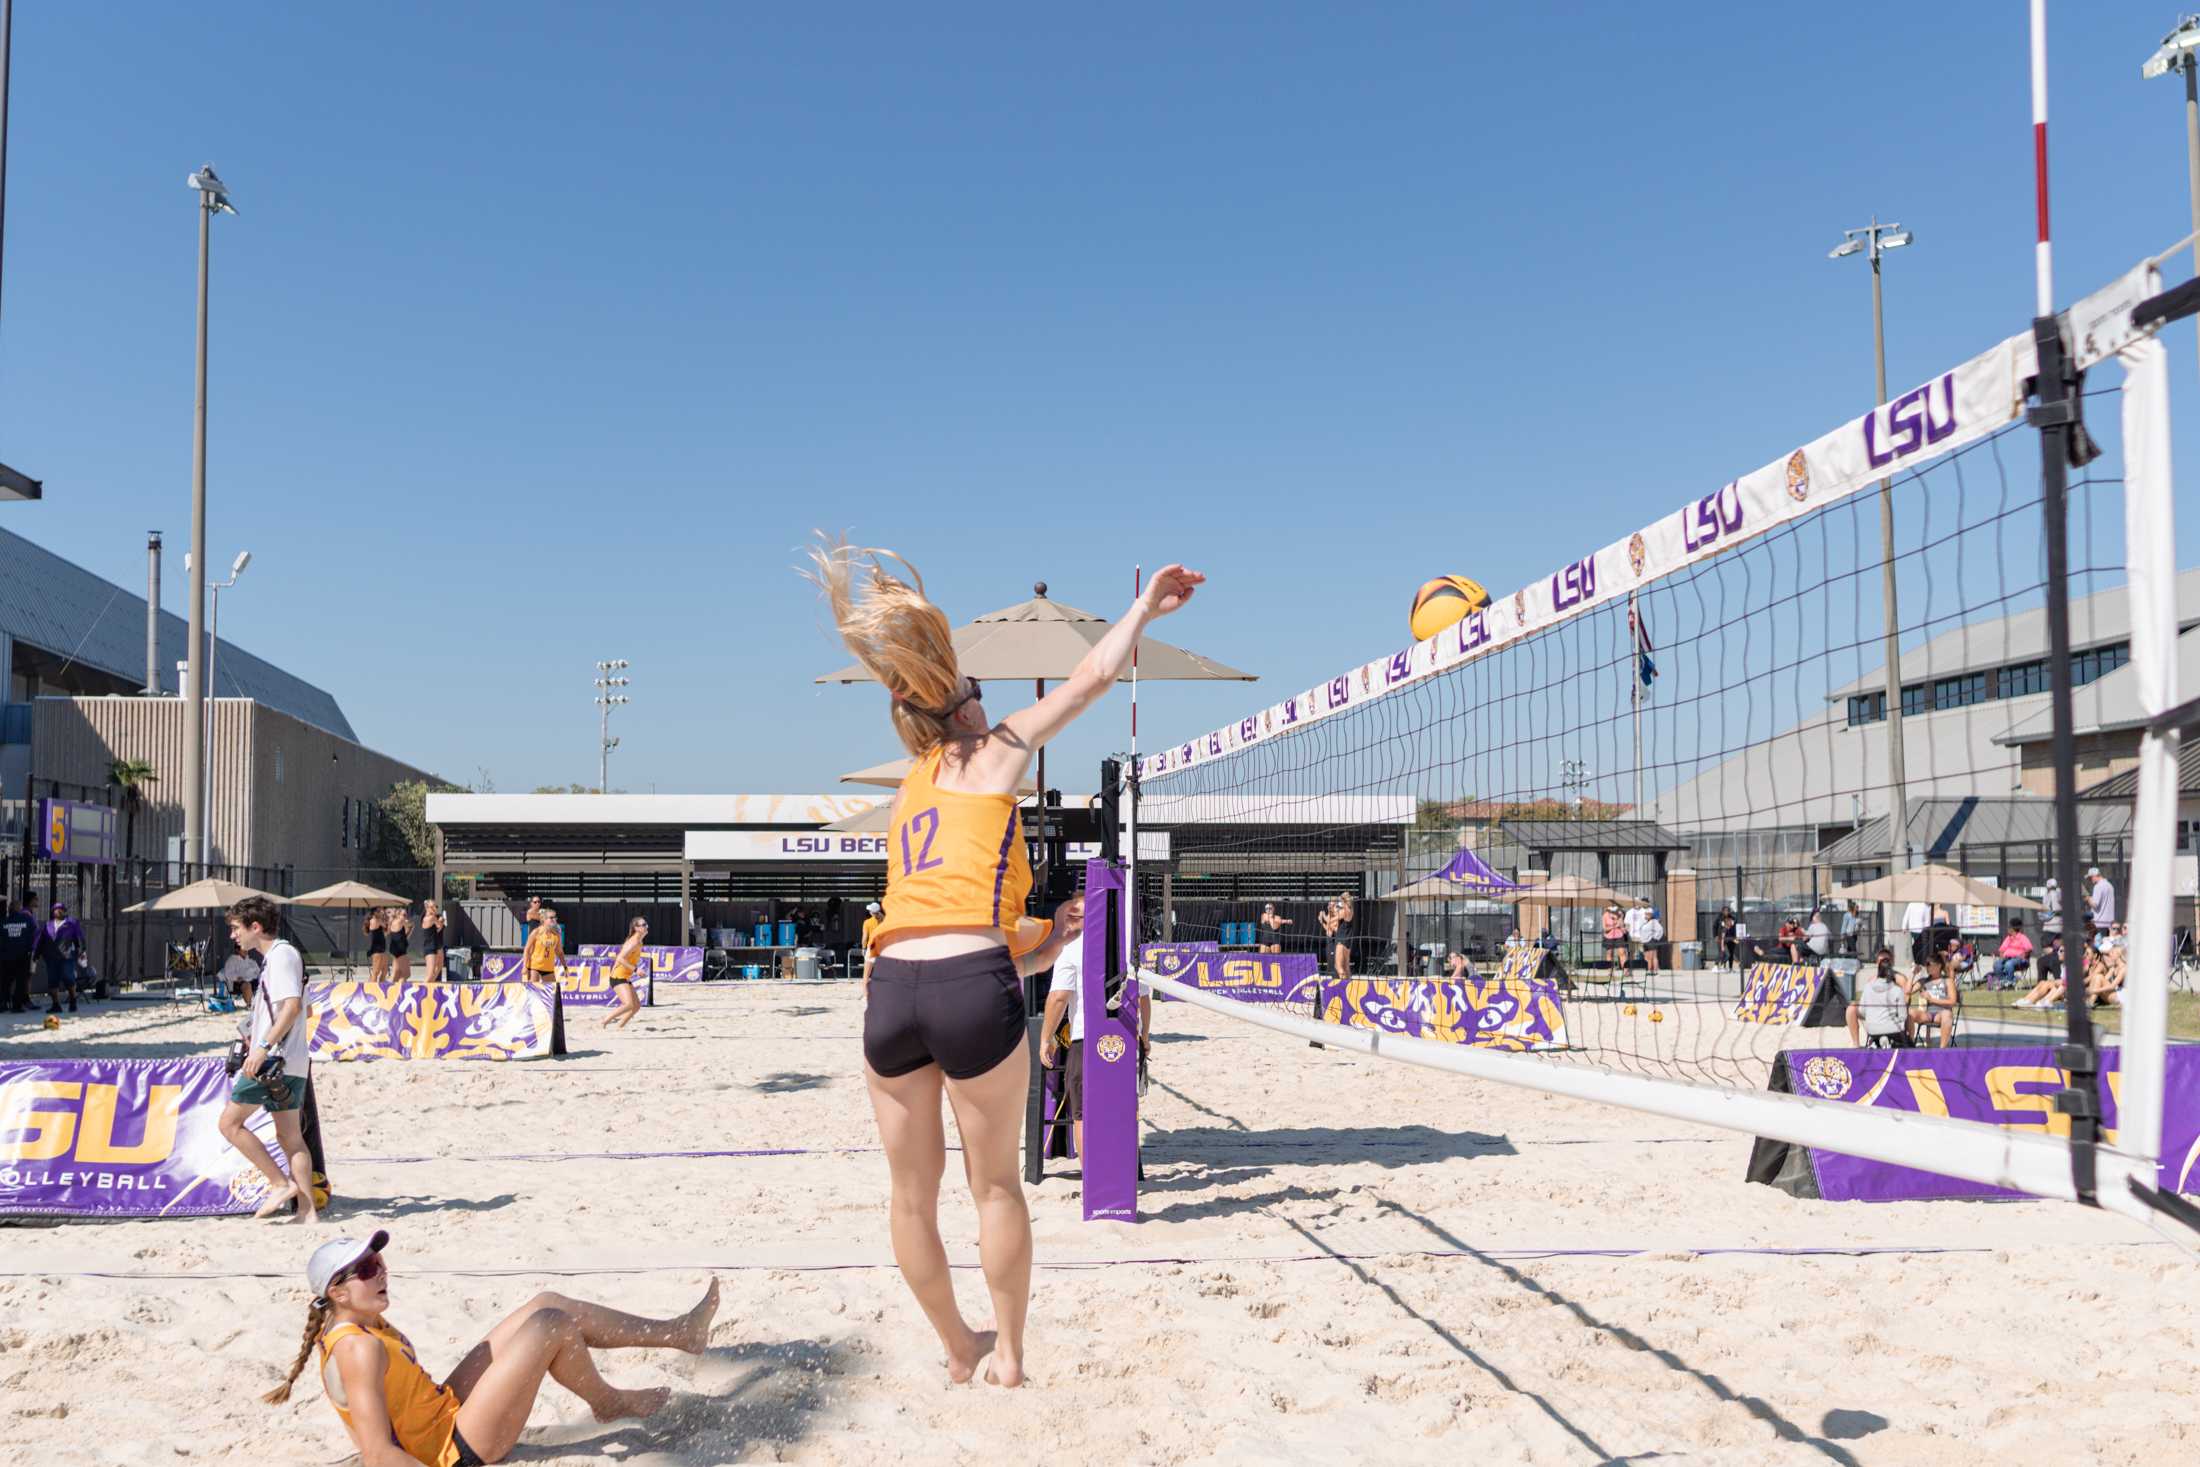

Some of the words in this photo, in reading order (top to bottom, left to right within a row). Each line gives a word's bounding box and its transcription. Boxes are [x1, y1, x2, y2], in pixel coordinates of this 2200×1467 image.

[1864, 373, 1957, 469] LSU
[1683, 480, 1744, 554] LSU
[1552, 554, 1596, 613] LSU
[1459, 605, 1492, 653] LSU
[1327, 672, 1349, 709] LSU
[51, 806, 65, 854] 5
[782, 838, 830, 853] LSU
[841, 838, 888, 853] BEA
[901, 807, 943, 876] 12
[555, 965, 611, 992] SU
[1197, 959, 1283, 988] LSU
[0, 1080, 182, 1164] SU
[3, 1170, 167, 1190] OLLEYBALL
